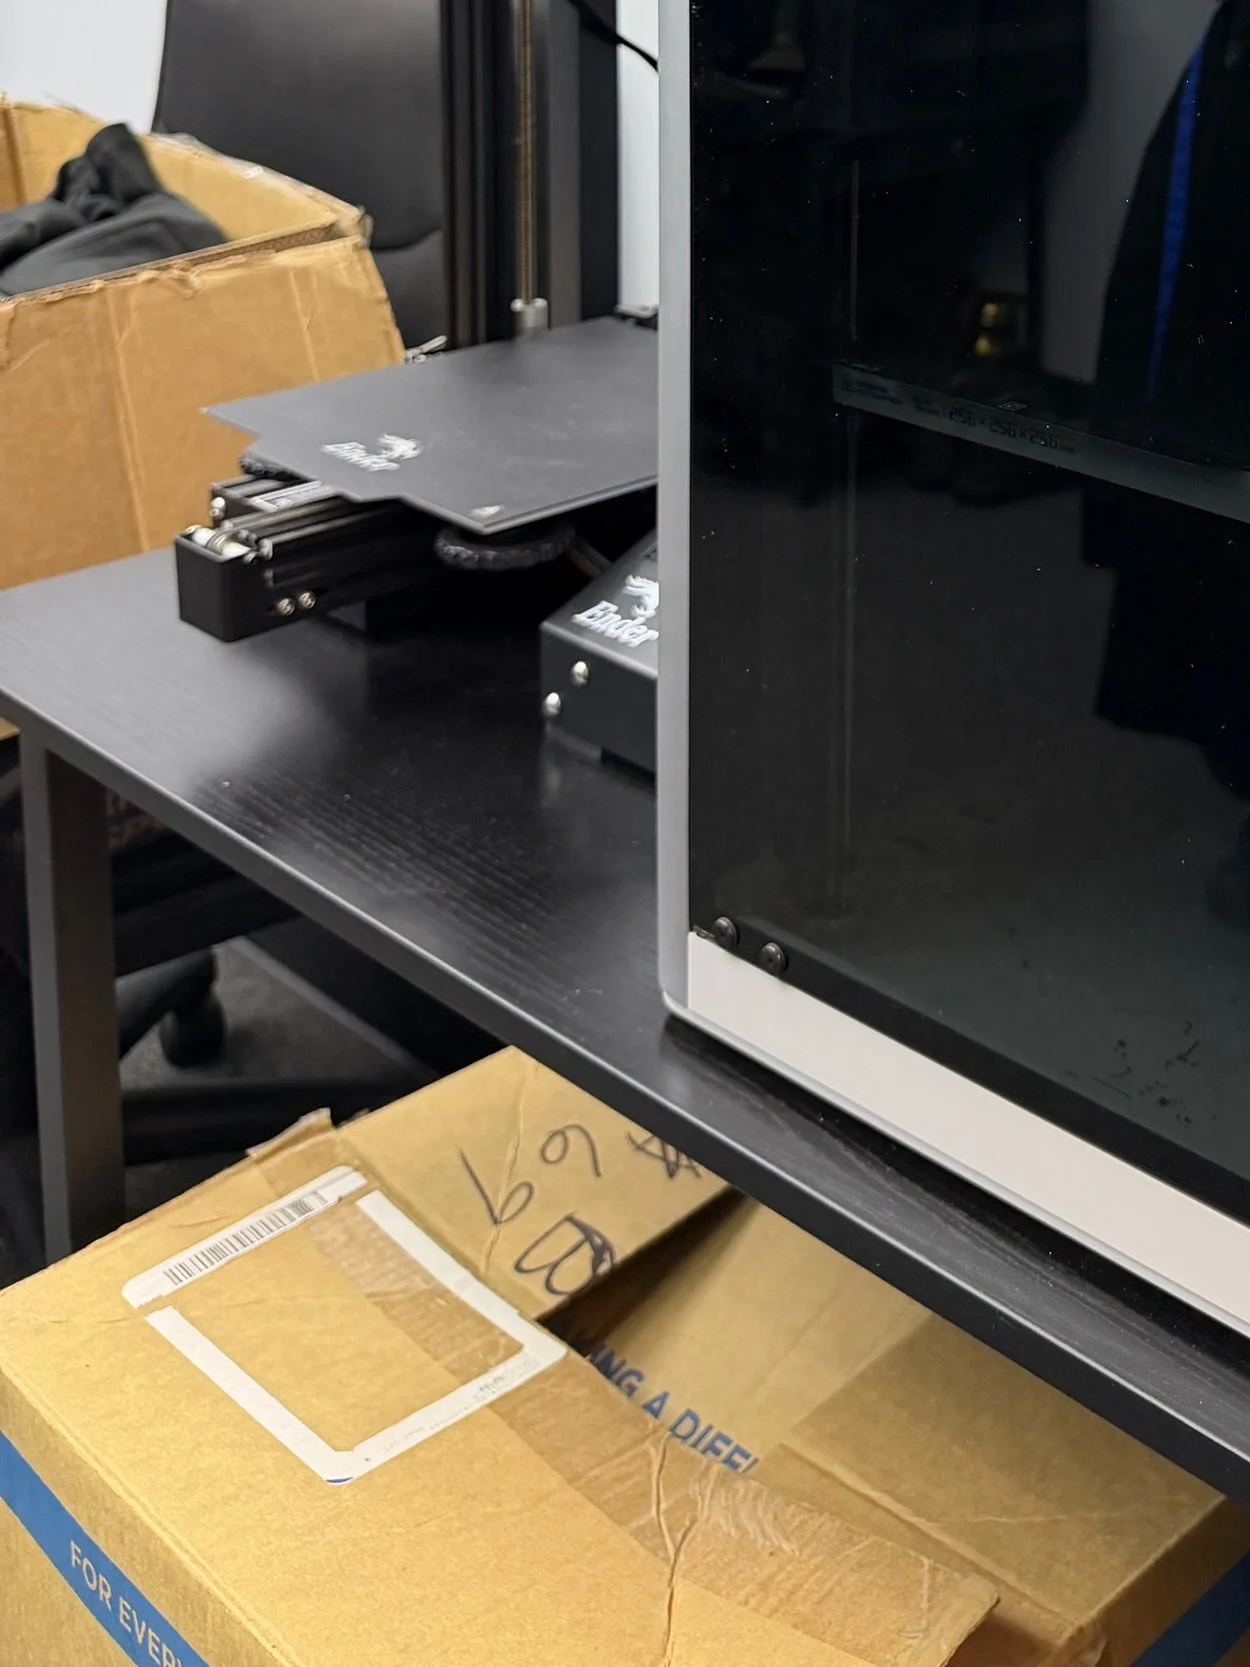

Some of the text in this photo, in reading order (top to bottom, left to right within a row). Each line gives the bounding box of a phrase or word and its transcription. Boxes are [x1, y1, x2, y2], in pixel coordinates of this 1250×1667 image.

[571, 600, 659, 647] Ender
[641, 1390, 670, 1420] A
[70, 1540, 112, 1612] FOR
